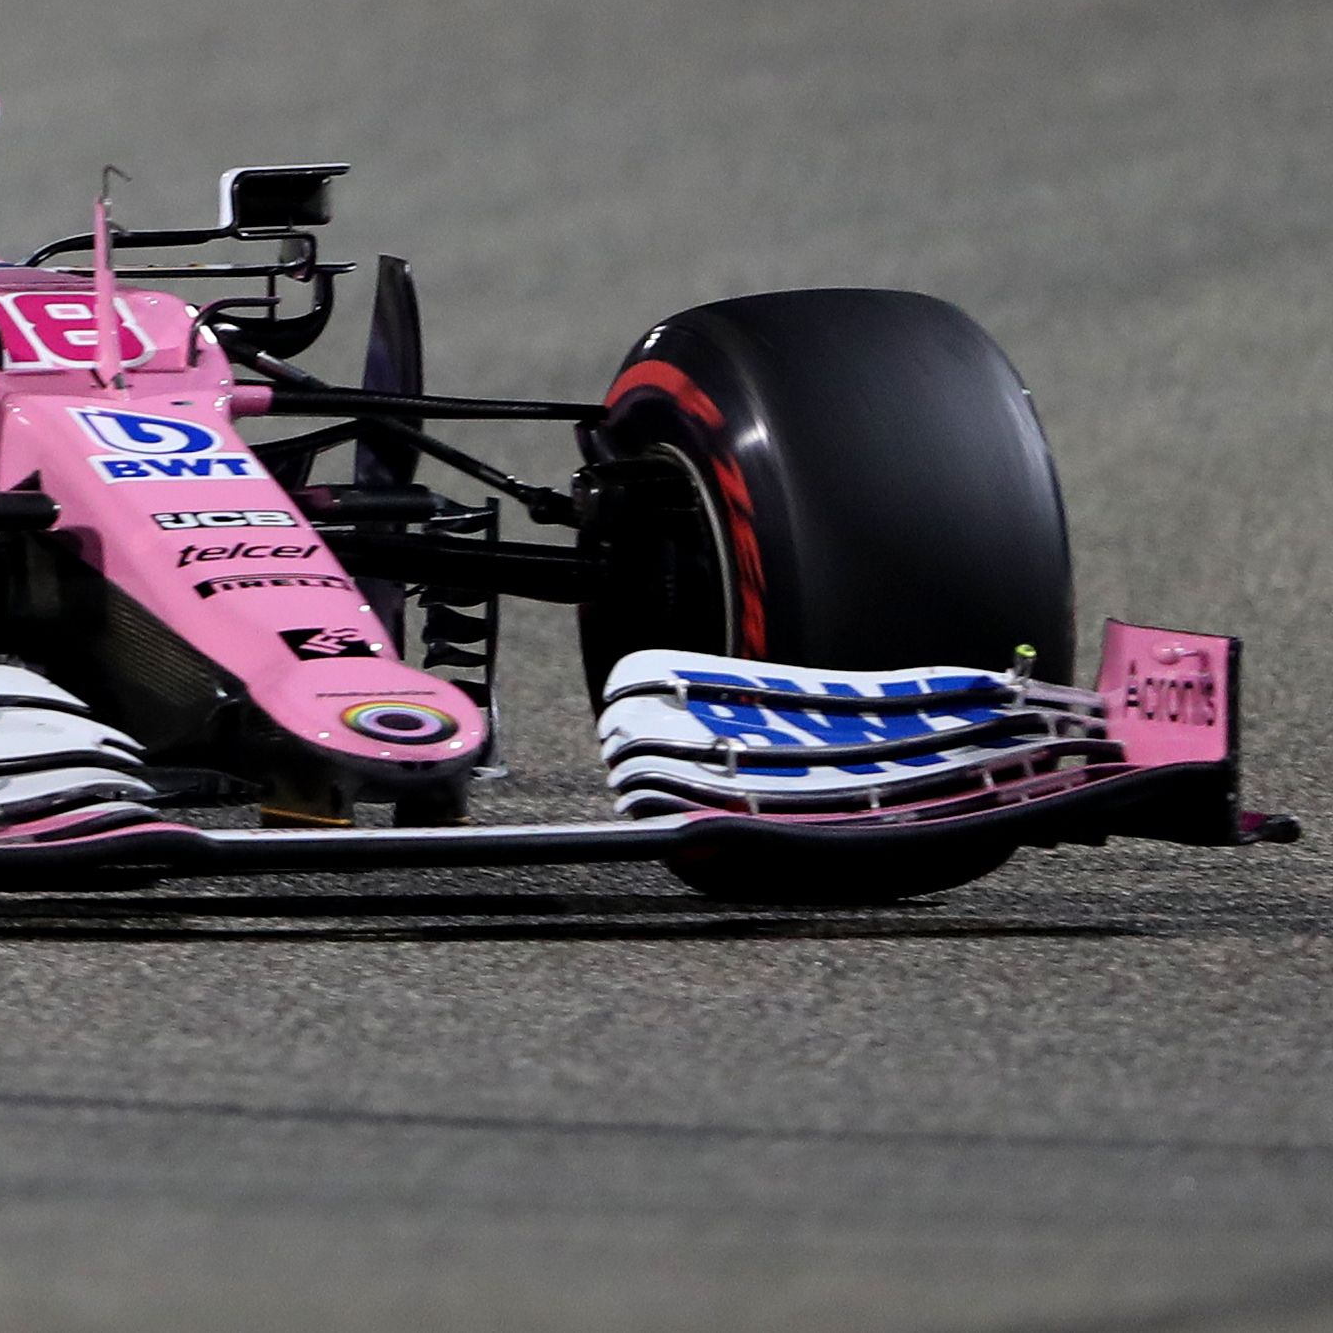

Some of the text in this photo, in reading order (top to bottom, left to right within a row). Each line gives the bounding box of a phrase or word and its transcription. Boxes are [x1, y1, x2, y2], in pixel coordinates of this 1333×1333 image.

[101, 458, 252, 479] BWT
[155, 512, 297, 528] JCB
[177, 542, 322, 569] telcel
